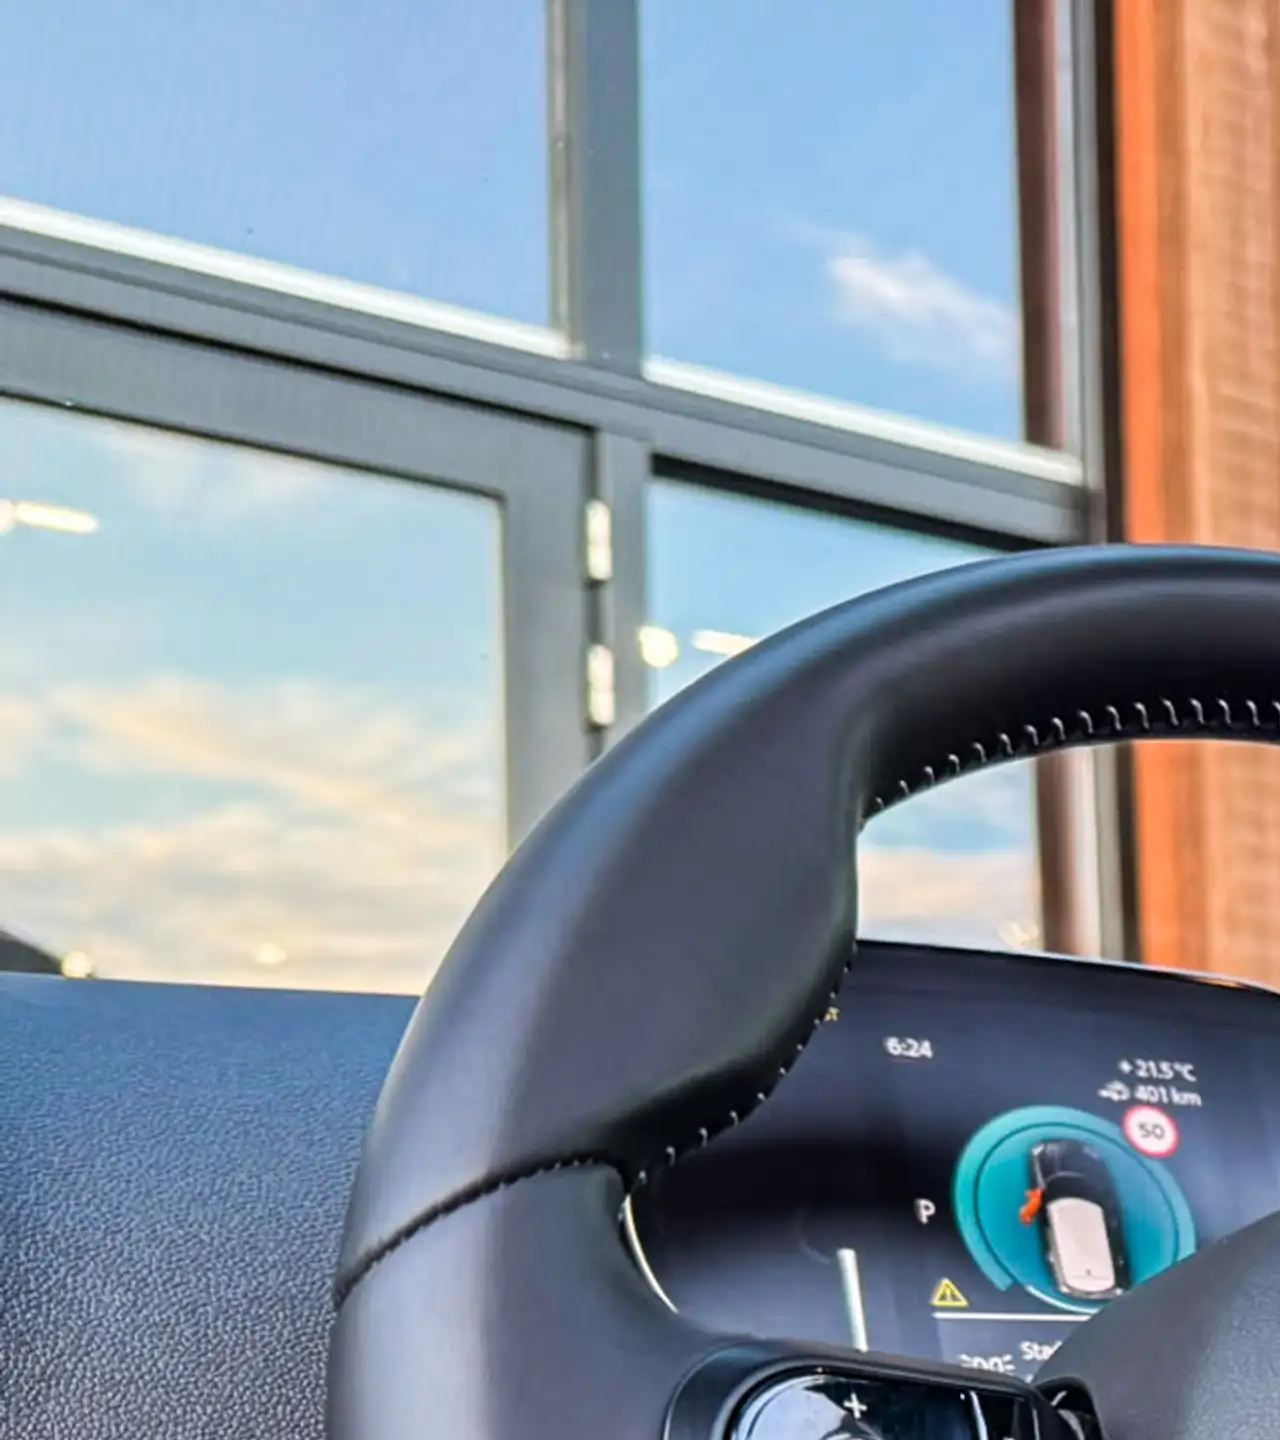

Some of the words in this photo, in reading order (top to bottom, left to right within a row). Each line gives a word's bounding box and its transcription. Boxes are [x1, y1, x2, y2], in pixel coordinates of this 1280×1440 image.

[1170, 1086, 1203, 1107] km
[1138, 1122, 1166, 1140] 50
[917, 1199, 936, 1224] P
